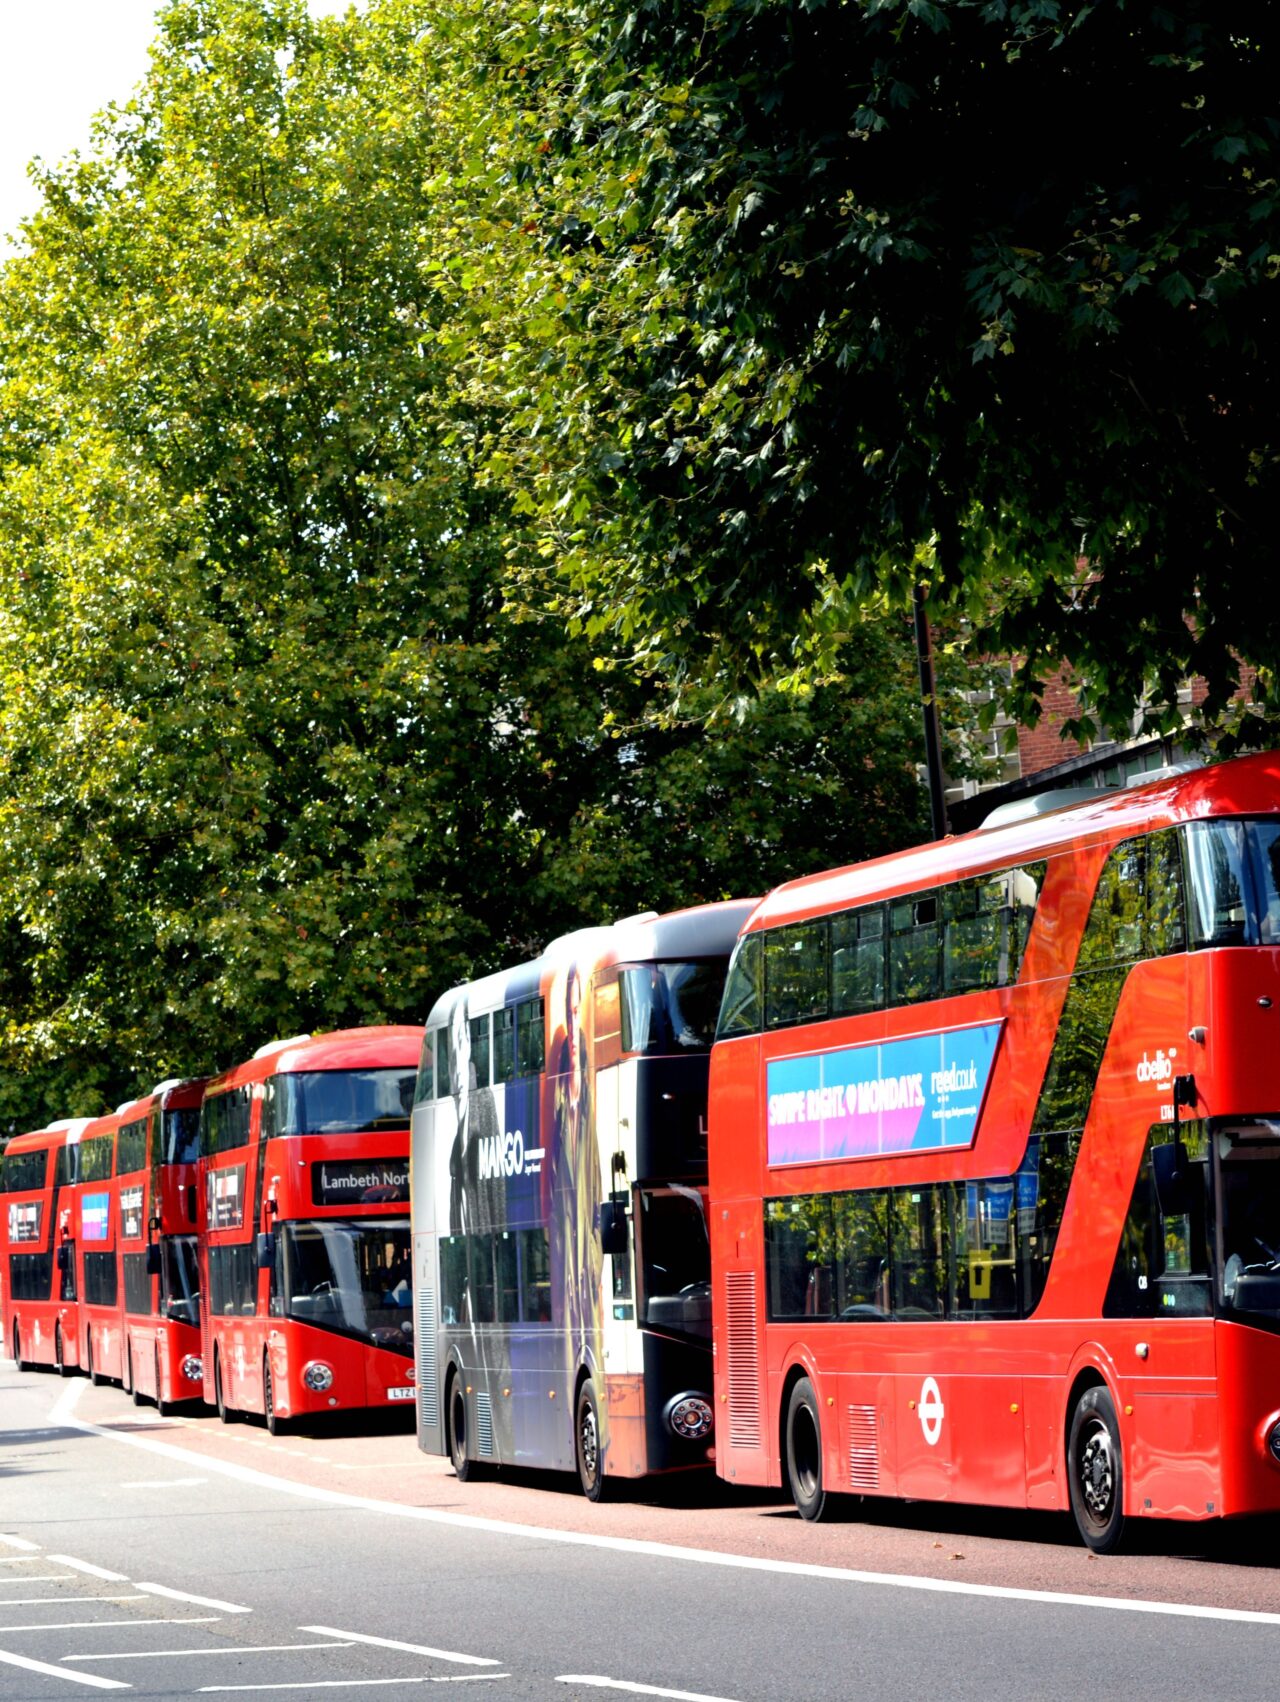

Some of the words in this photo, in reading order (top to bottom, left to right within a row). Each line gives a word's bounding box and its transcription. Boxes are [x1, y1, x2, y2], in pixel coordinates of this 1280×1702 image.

[769, 1090, 805, 1126] SWIPE
[807, 1085, 845, 1121] RIGHT
[478, 1130, 524, 1180] MANGO
[324, 1173, 380, 1188] Lambeth
